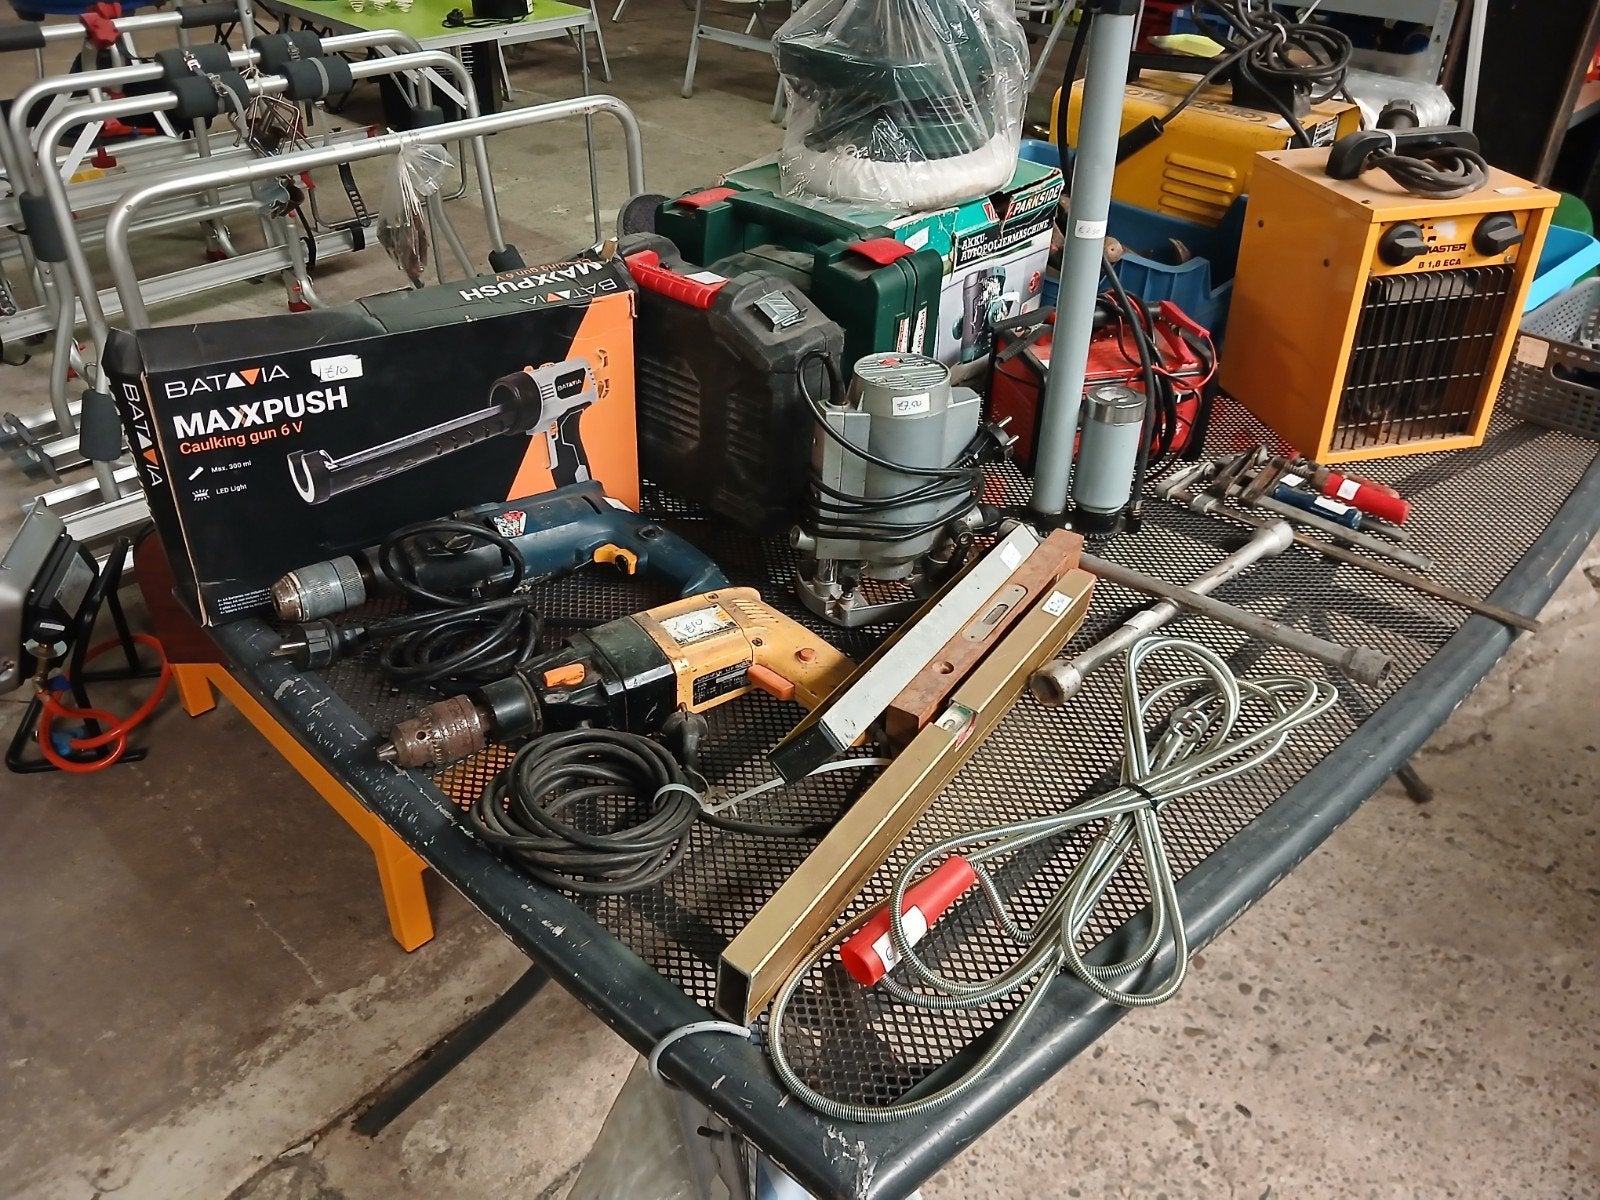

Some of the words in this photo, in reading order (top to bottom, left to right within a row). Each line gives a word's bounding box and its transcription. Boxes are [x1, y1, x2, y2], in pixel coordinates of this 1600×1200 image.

[1014, 183, 1061, 216] PARKSIDE
[960, 232, 988, 251] AKKU-
[1443, 258, 1461, 267] ECA
[458, 261, 603, 301] MAXXPUSH
[519, 278, 619, 305] BATAVIA
[164, 364, 290, 399] BATAVIA
[172, 385, 349, 439] MAXXPUSH
[122, 382, 163, 486] BATAVIA
[180, 433, 246, 455] Caulking
[249, 427, 277, 445] gun
[280, 423, 290, 436] 6
[291, 420, 303, 433] V
[228, 462, 242, 470] 300
[215, 487, 229, 495] LED
[230, 483, 247, 492] Light
